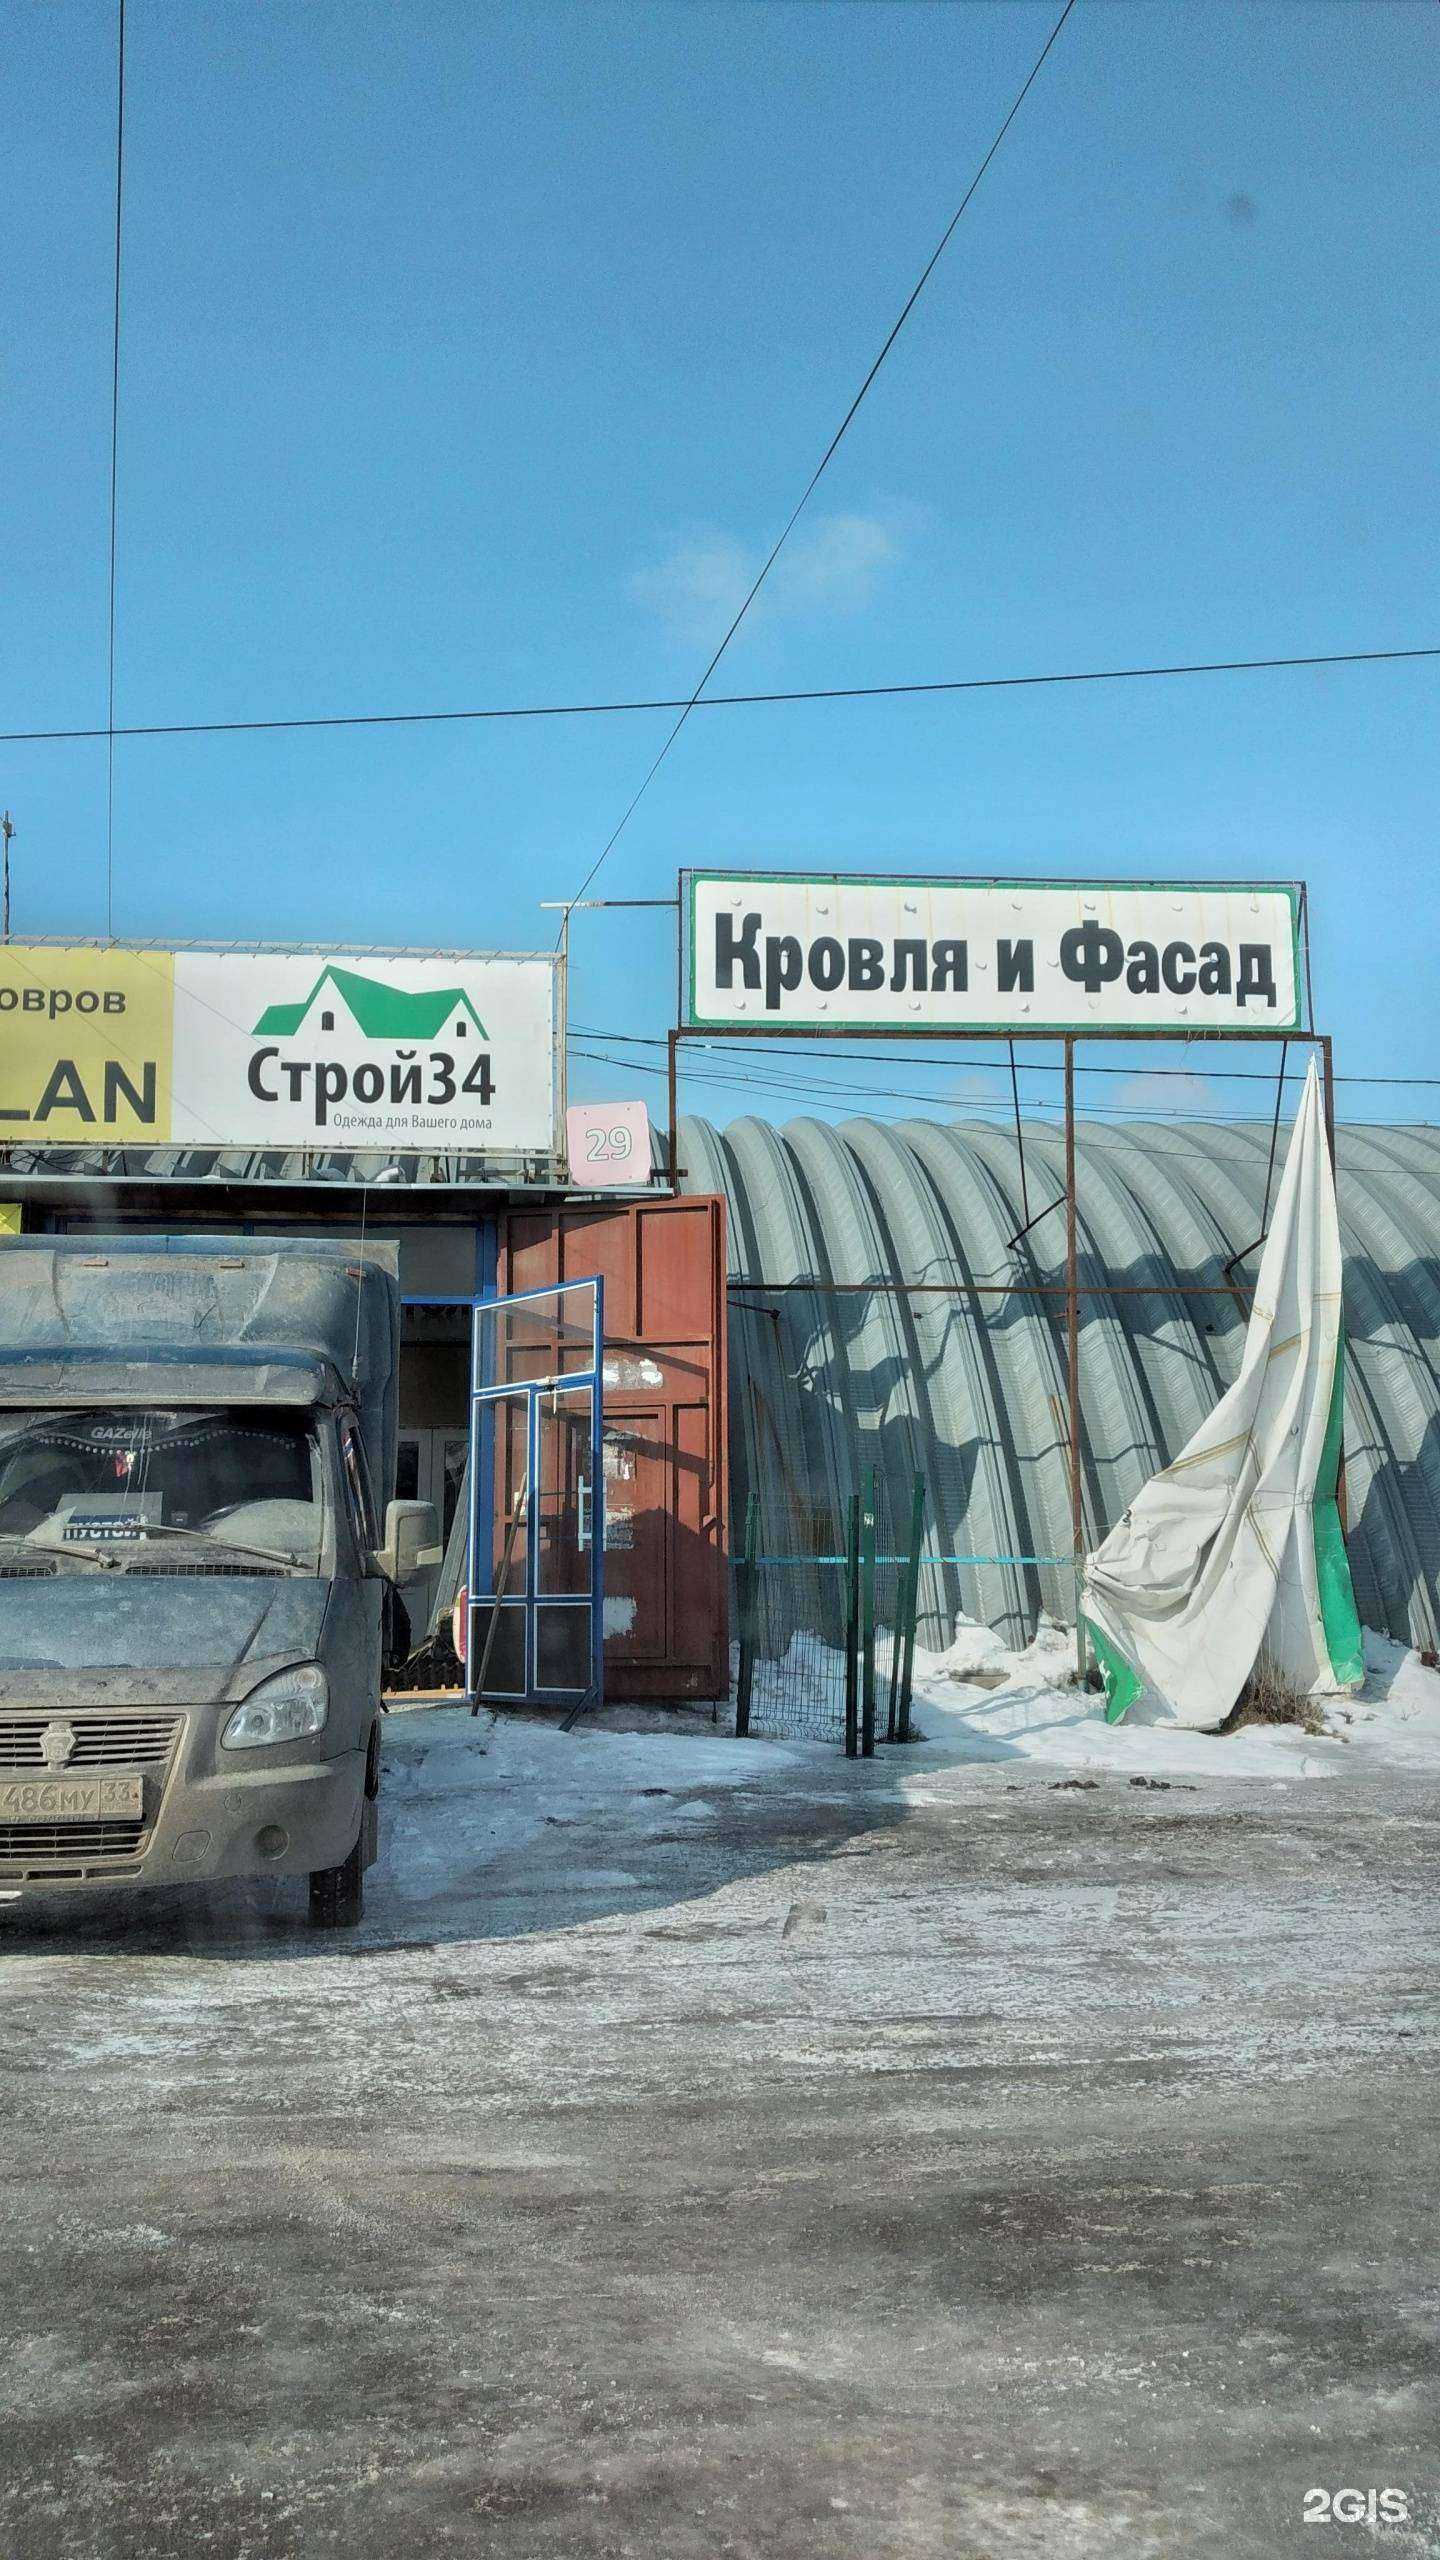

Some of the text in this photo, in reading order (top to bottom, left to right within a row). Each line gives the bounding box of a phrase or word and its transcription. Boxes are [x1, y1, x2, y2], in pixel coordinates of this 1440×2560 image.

[714, 911, 1278, 1010] Кровля и Фасад
[0, 987, 126, 1020] овров
[247, 1046, 496, 1126] Строй34
[333, 1113, 493, 1130] Одежда для Вашего дома
[585, 1125, 632, 1162] 29
